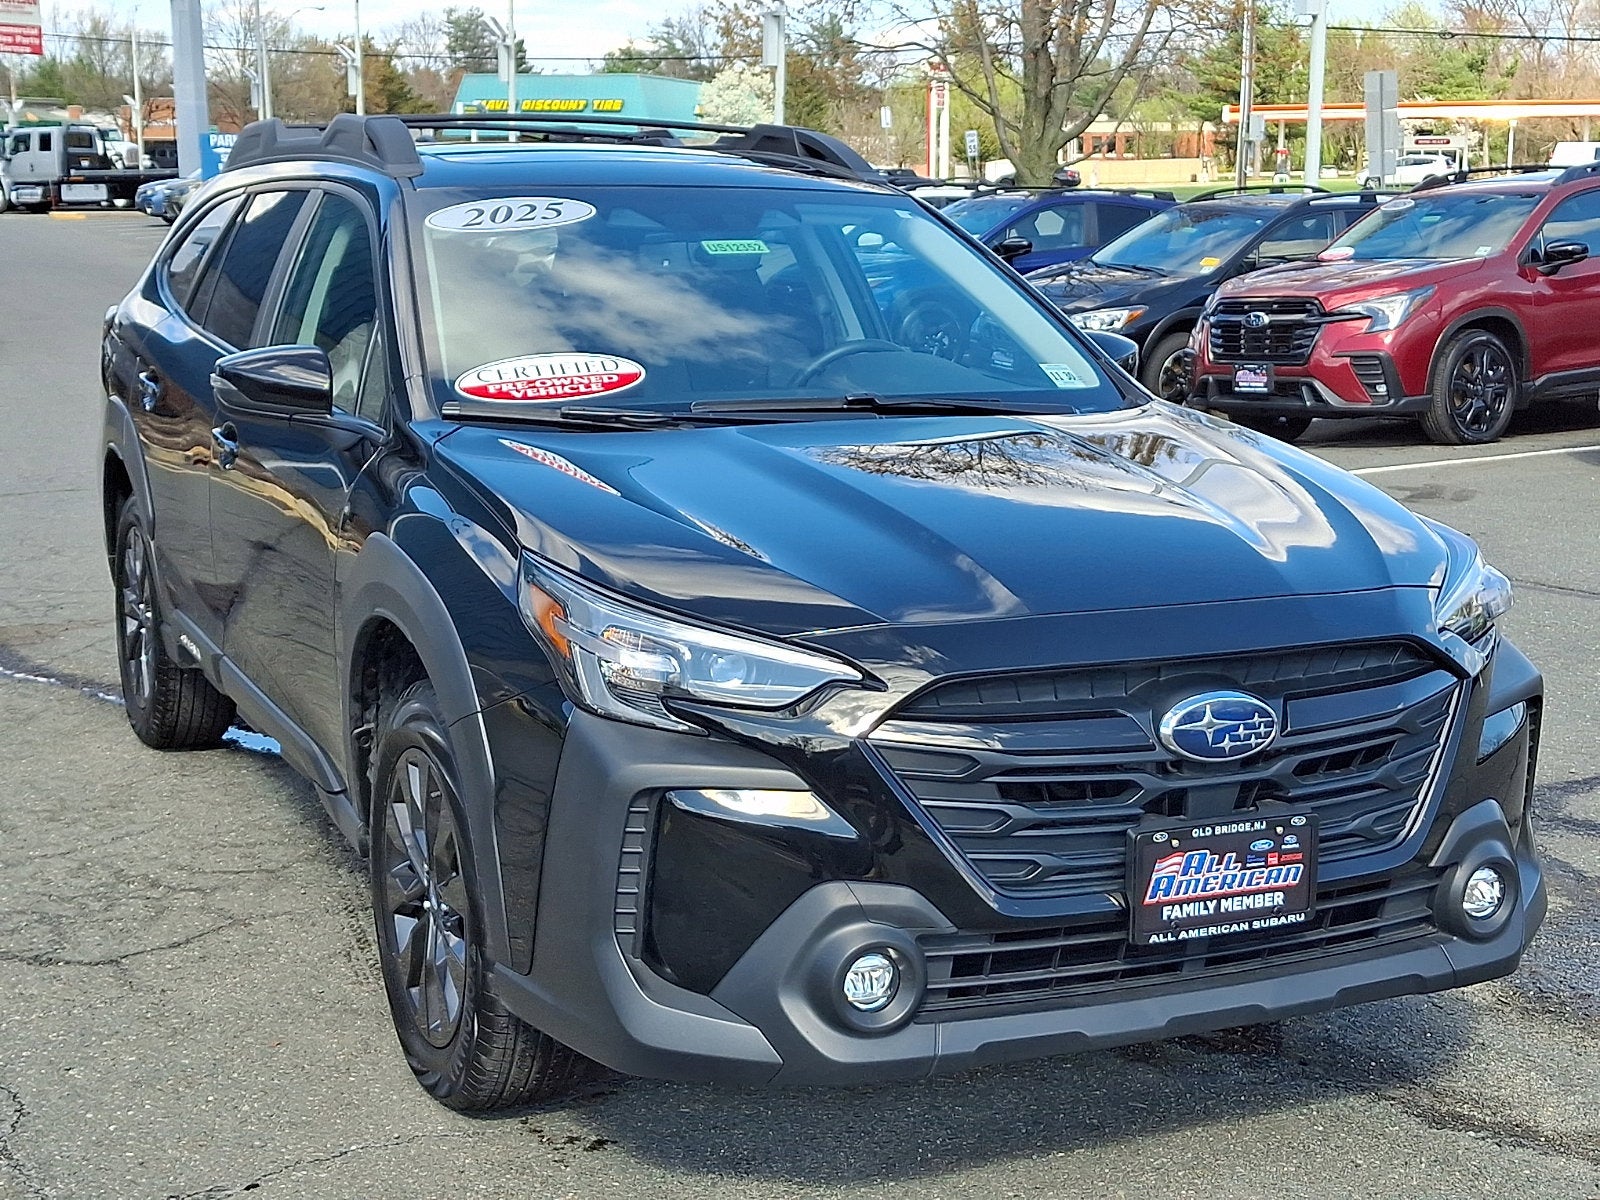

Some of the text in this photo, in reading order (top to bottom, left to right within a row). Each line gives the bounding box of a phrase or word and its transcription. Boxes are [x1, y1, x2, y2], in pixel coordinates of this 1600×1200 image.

[521, 99, 587, 111] DISCOUNT
[592, 99, 623, 111] TIRE
[968, 145, 977, 153] 55
[462, 202, 564, 227] 2025
[707, 243, 764, 252] US12352
[477, 359, 619, 382] CERTIFIED
[486, 374, 619, 393] PRE-OWNED
[510, 383, 604, 399] VEHICLE
[1192, 828, 1212, 838] OLD
[1162, 891, 1284, 921] FAMILY MEMBER
[1149, 913, 1305, 944] ALL AMERICAN SUBARU
